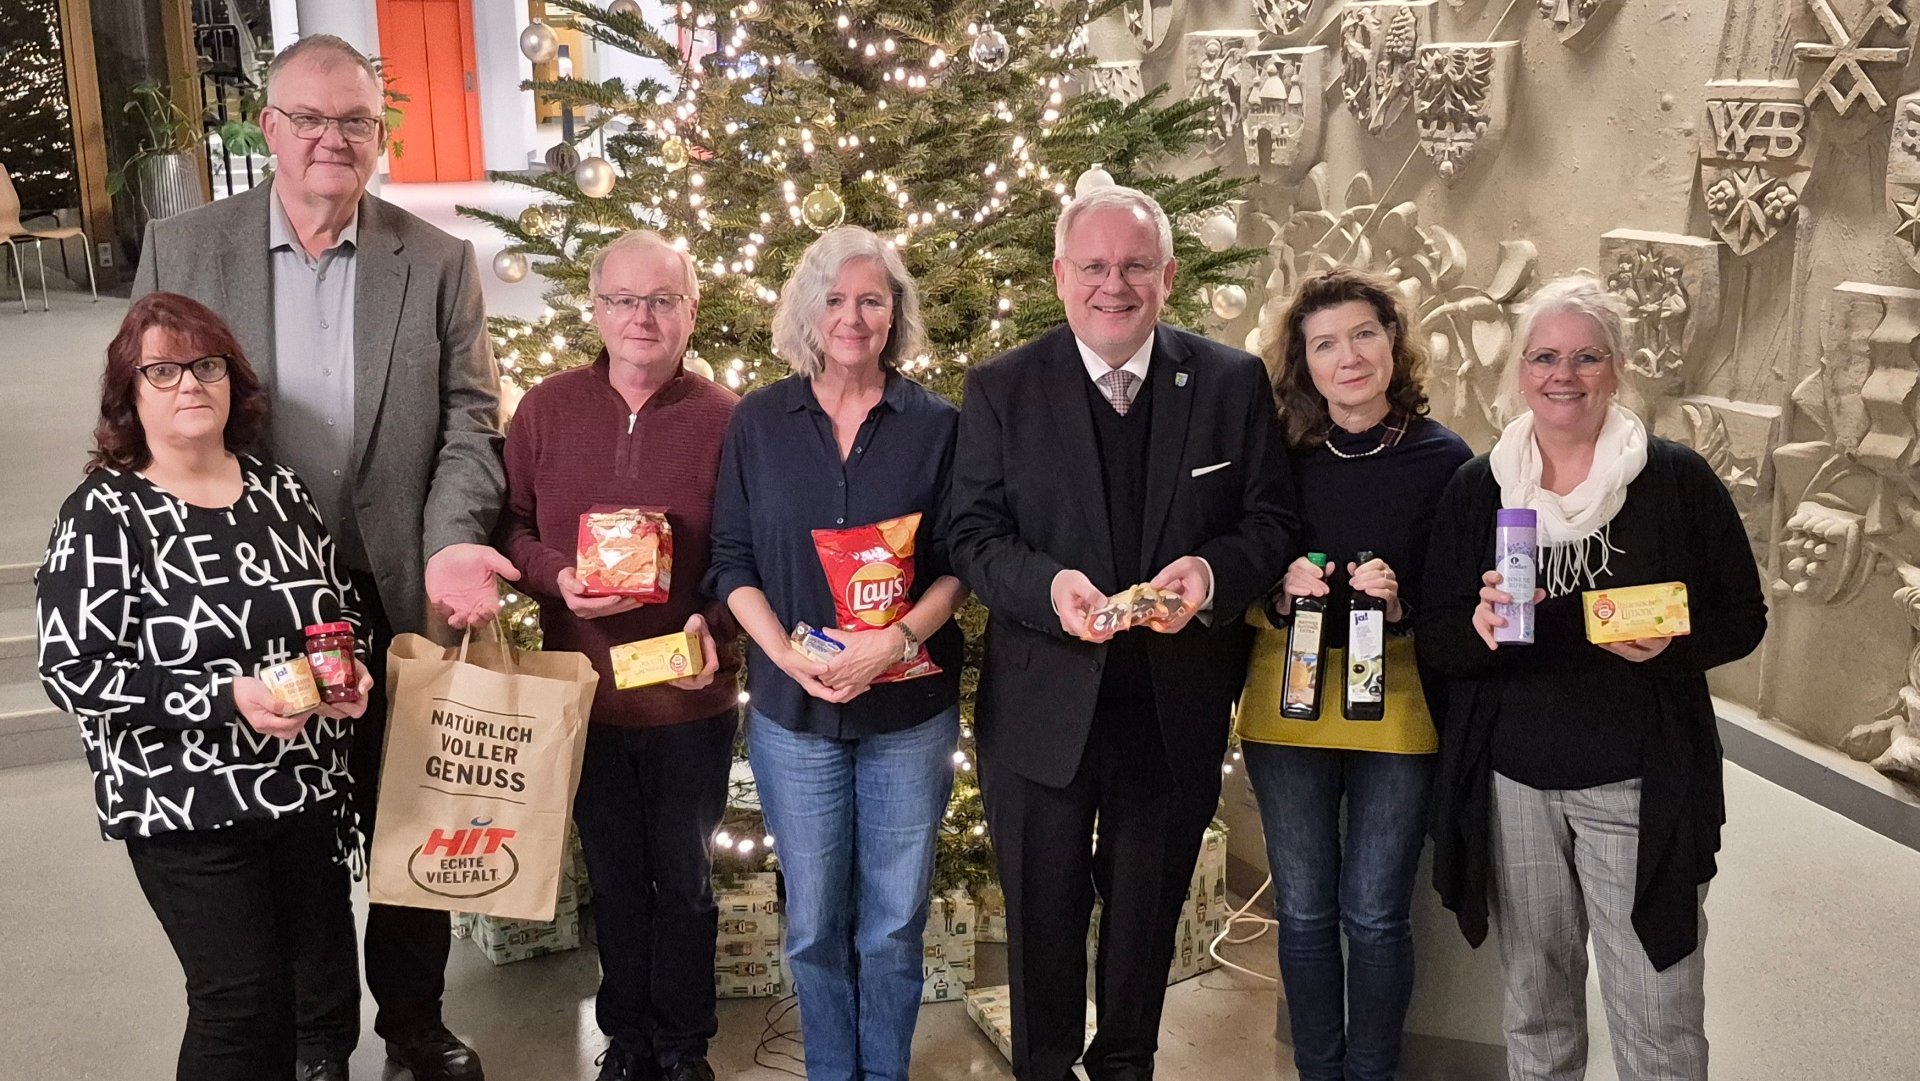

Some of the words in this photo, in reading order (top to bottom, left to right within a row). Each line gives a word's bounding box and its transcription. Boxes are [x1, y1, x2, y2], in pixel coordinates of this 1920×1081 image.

[853, 577, 904, 612] Lay's
[1354, 612, 1369, 626] ja!
[273, 667, 288, 682] ja!
[431, 709, 533, 744] NATÜRLICH
[441, 733, 519, 765] VOLLER
[425, 755, 527, 793] GENUSS
[422, 828, 518, 857] HIT
[440, 857, 485, 870] ECHTE
